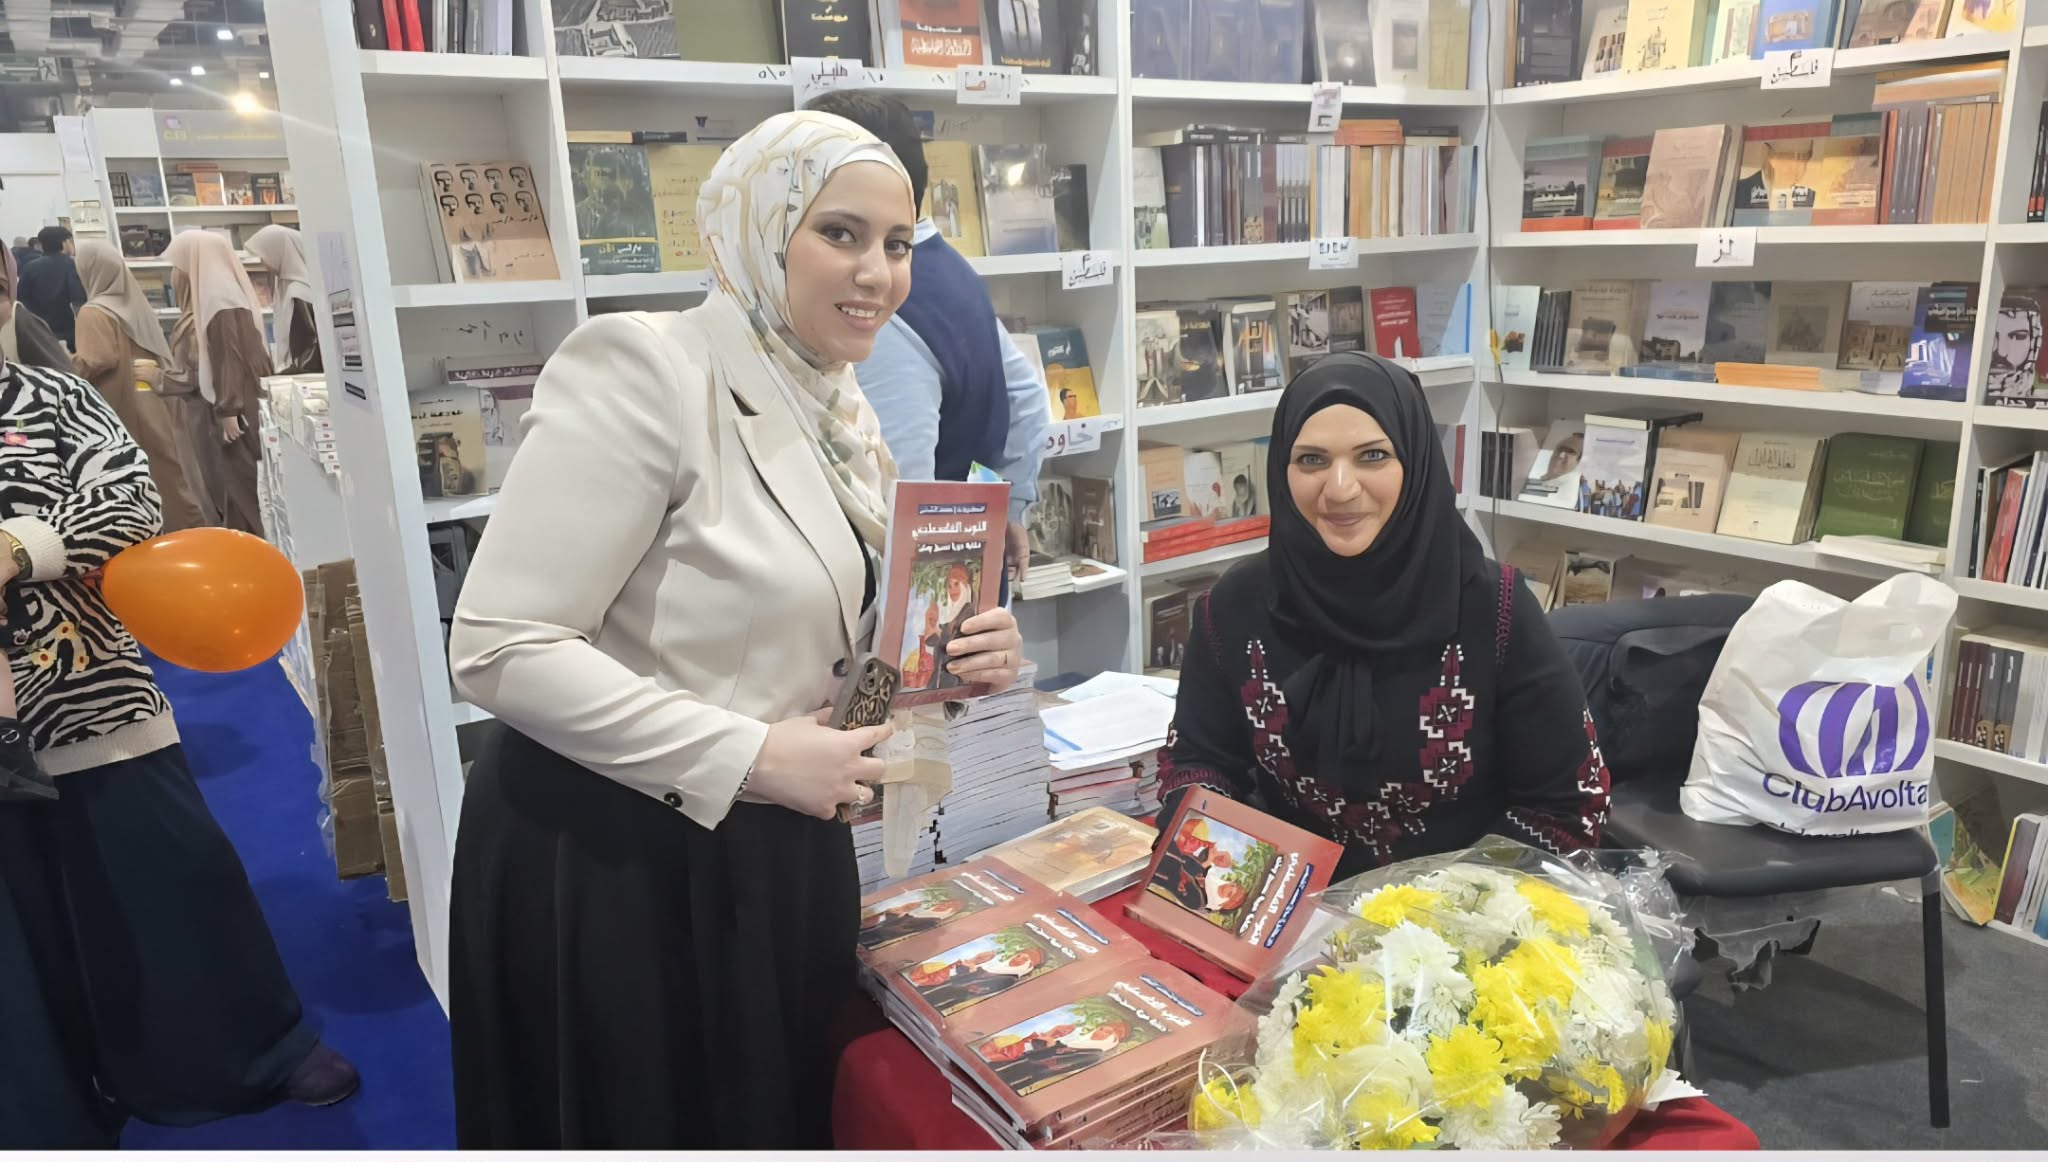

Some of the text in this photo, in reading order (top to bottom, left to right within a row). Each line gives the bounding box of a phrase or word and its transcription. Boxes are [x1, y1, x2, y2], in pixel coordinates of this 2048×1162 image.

[1770, 50, 1819, 85] فلسطين
[1068, 253, 1107, 288] فلسطين
[1762, 772, 1928, 814] ClubAvolta
